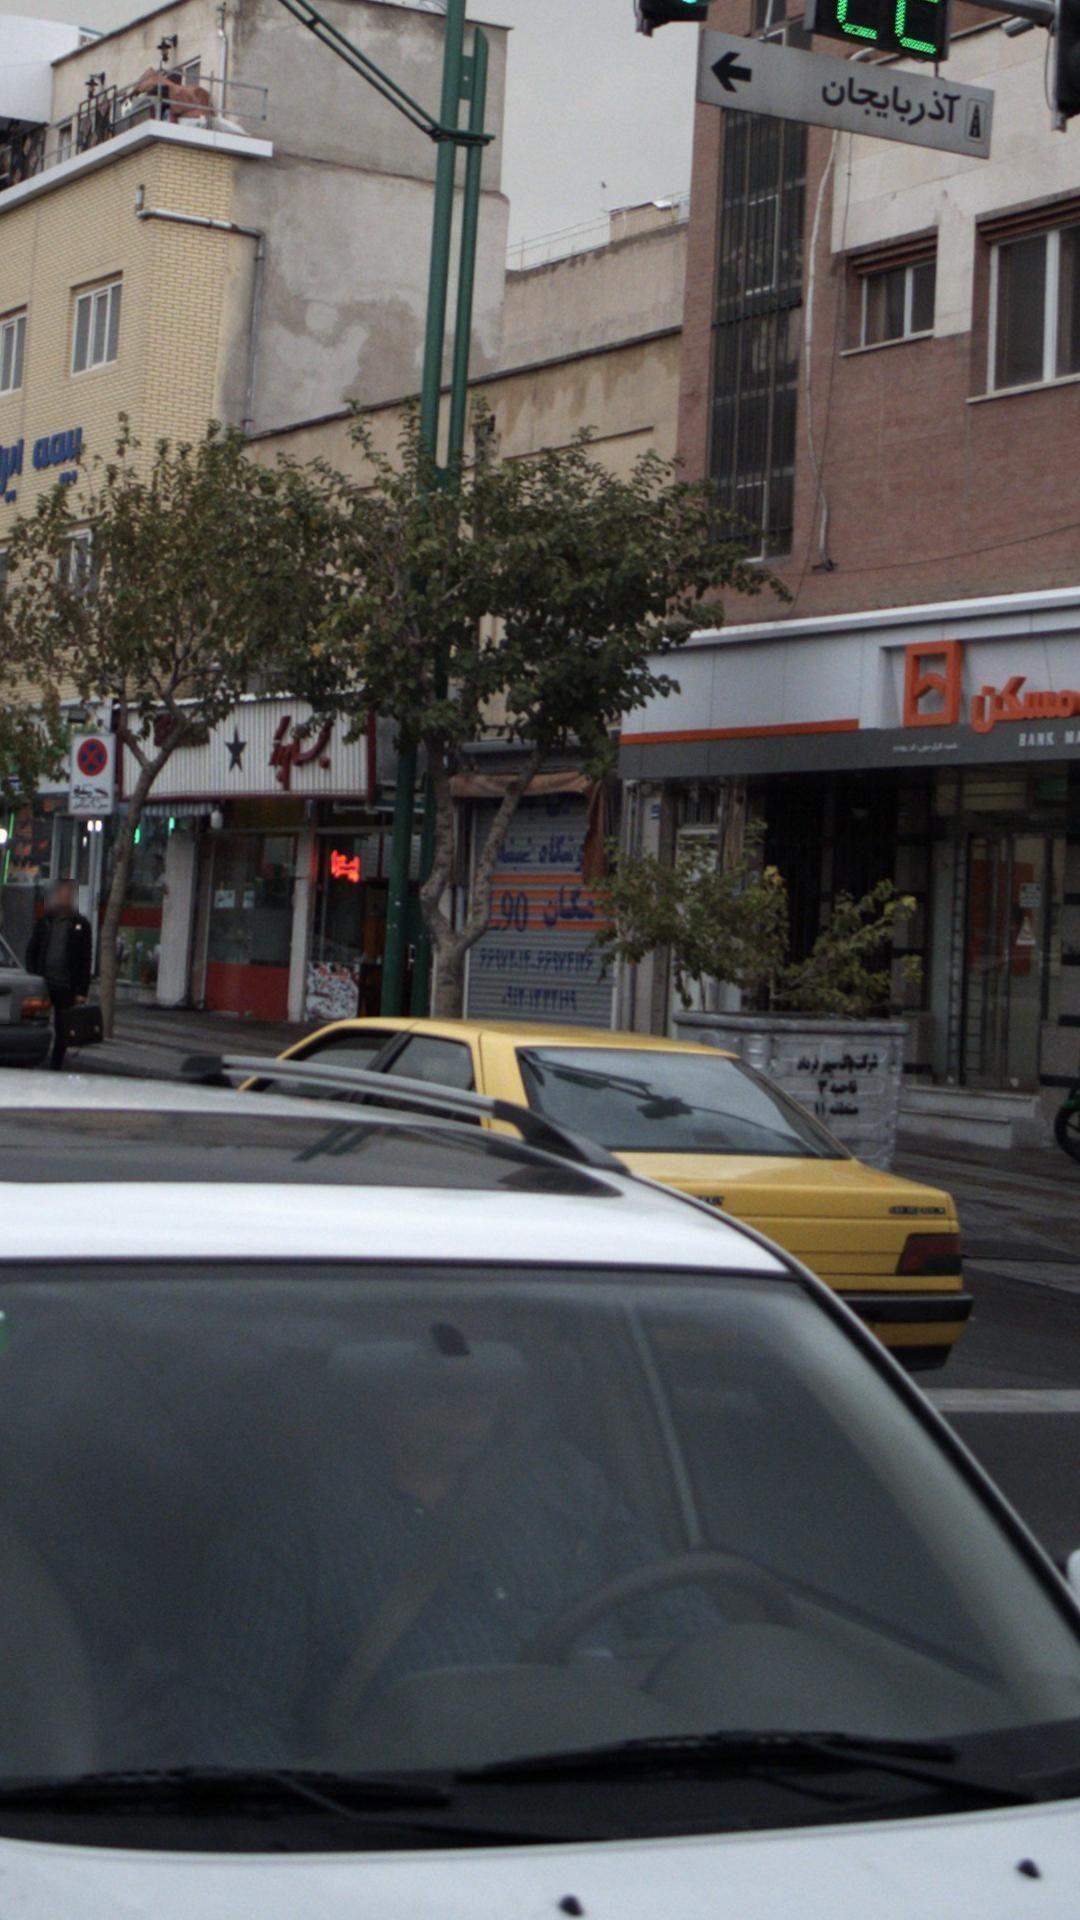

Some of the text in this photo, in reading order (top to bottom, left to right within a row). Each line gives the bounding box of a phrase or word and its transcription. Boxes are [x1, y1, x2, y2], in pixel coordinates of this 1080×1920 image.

[822, 77, 961, 125] آذربایجان
[32, 426, 83, 487] بیمه
[971, 676, 1080, 734] مسکن
[1018, 732, 1055, 747] BANK
